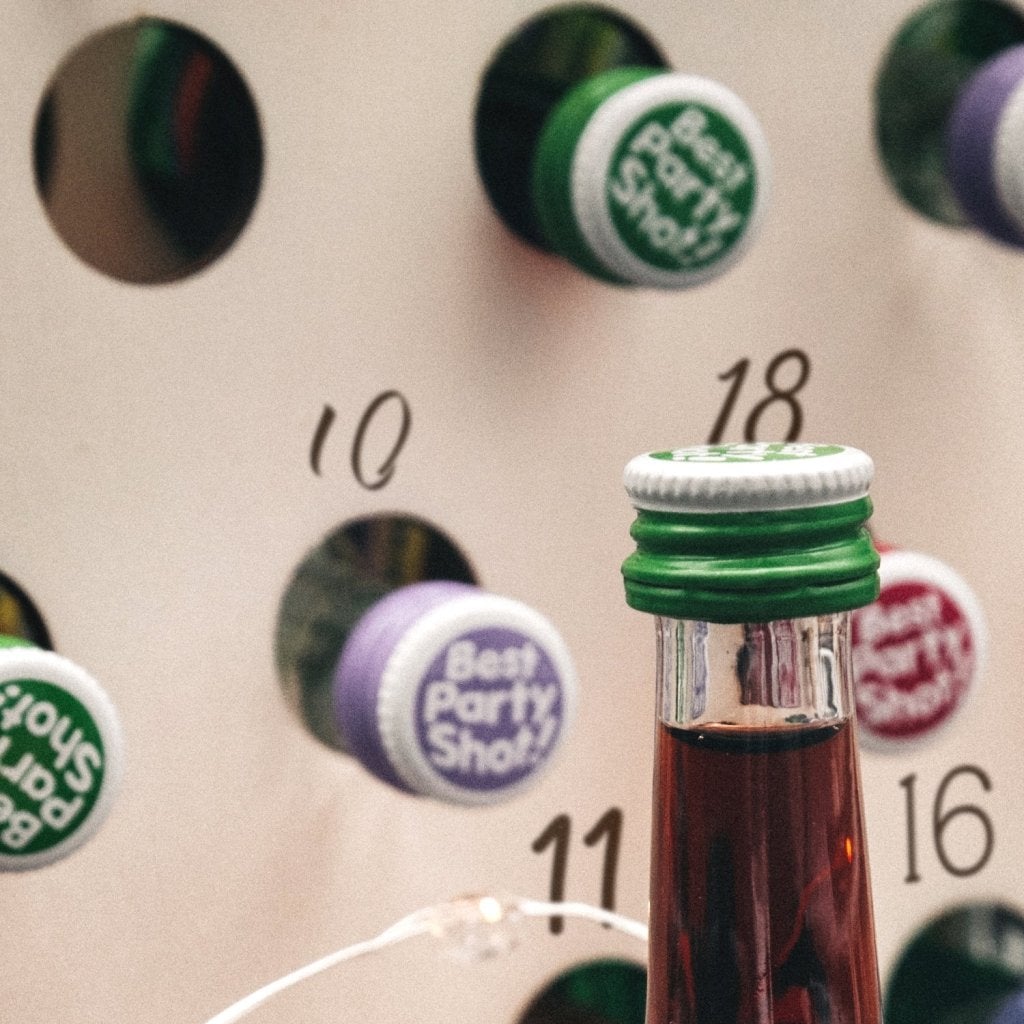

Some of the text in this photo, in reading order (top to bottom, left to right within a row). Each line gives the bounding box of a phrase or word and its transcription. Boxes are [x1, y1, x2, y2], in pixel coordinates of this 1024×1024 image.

[630, 121, 742, 235] Party
[670, 106, 747, 191] Best
[309, 389, 412, 491] 10
[708, 348, 811, 444] 18
[425, 679, 557, 726] Party
[446, 640, 538, 681] Best
[0, 734, 84, 831] Par
[428, 717, 557, 774] Shot!
[531, 806, 624, 935] 11
[900, 764, 995, 884] 16
